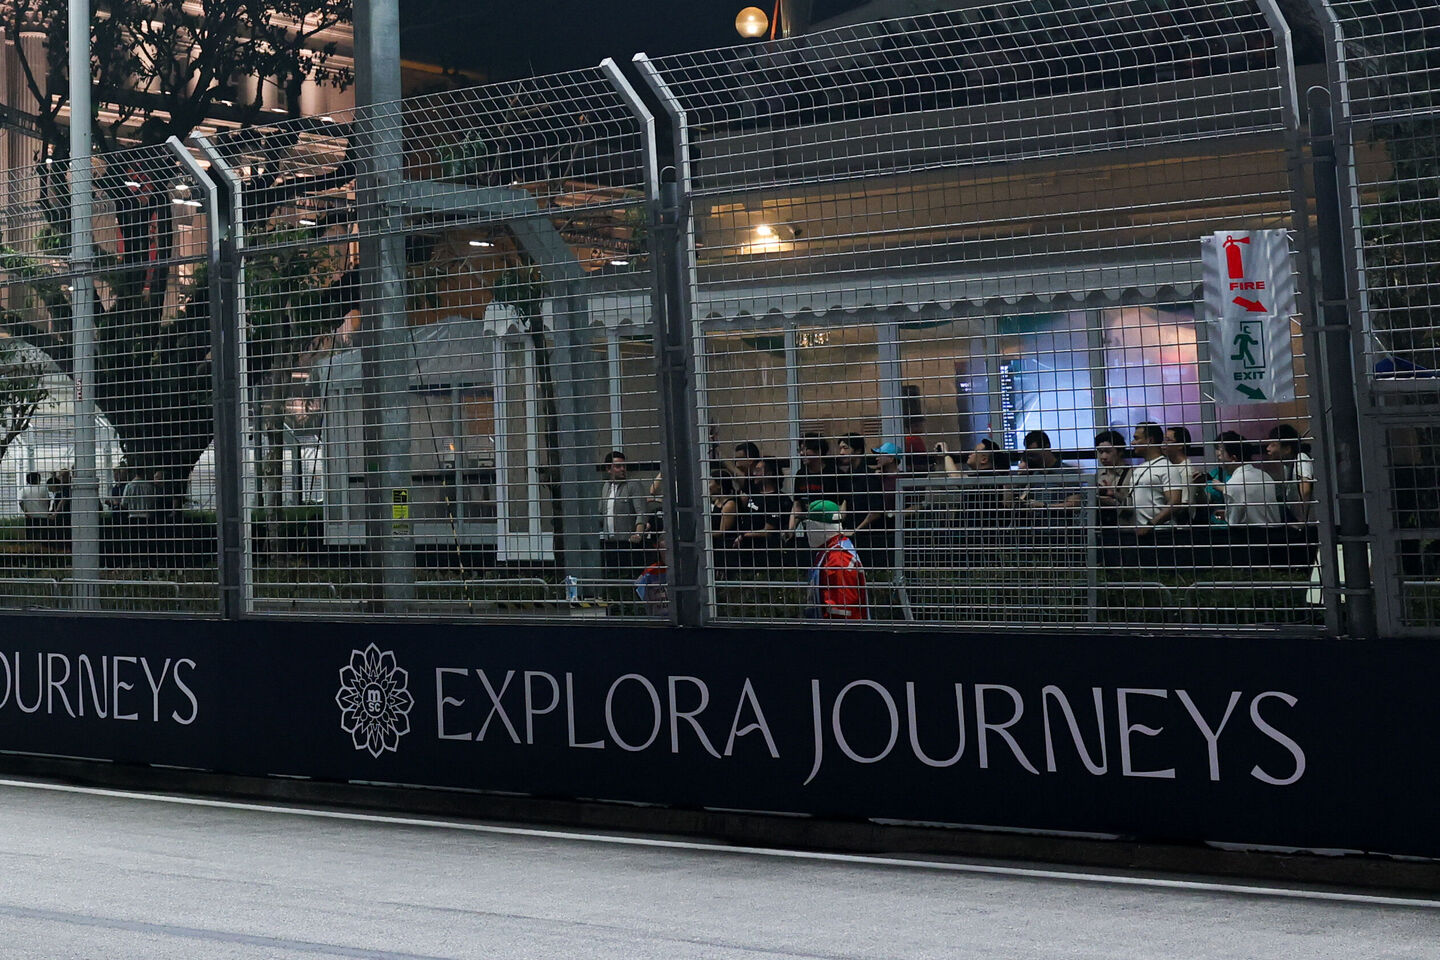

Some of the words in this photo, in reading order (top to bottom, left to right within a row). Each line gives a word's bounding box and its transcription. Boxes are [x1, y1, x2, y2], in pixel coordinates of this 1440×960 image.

[1229, 281, 1266, 291] FIRE
[1233, 371, 1266, 381] EXIT
[435, 667, 781, 759] EXPLORA
[803, 678, 1306, 787] JOURNEYS
